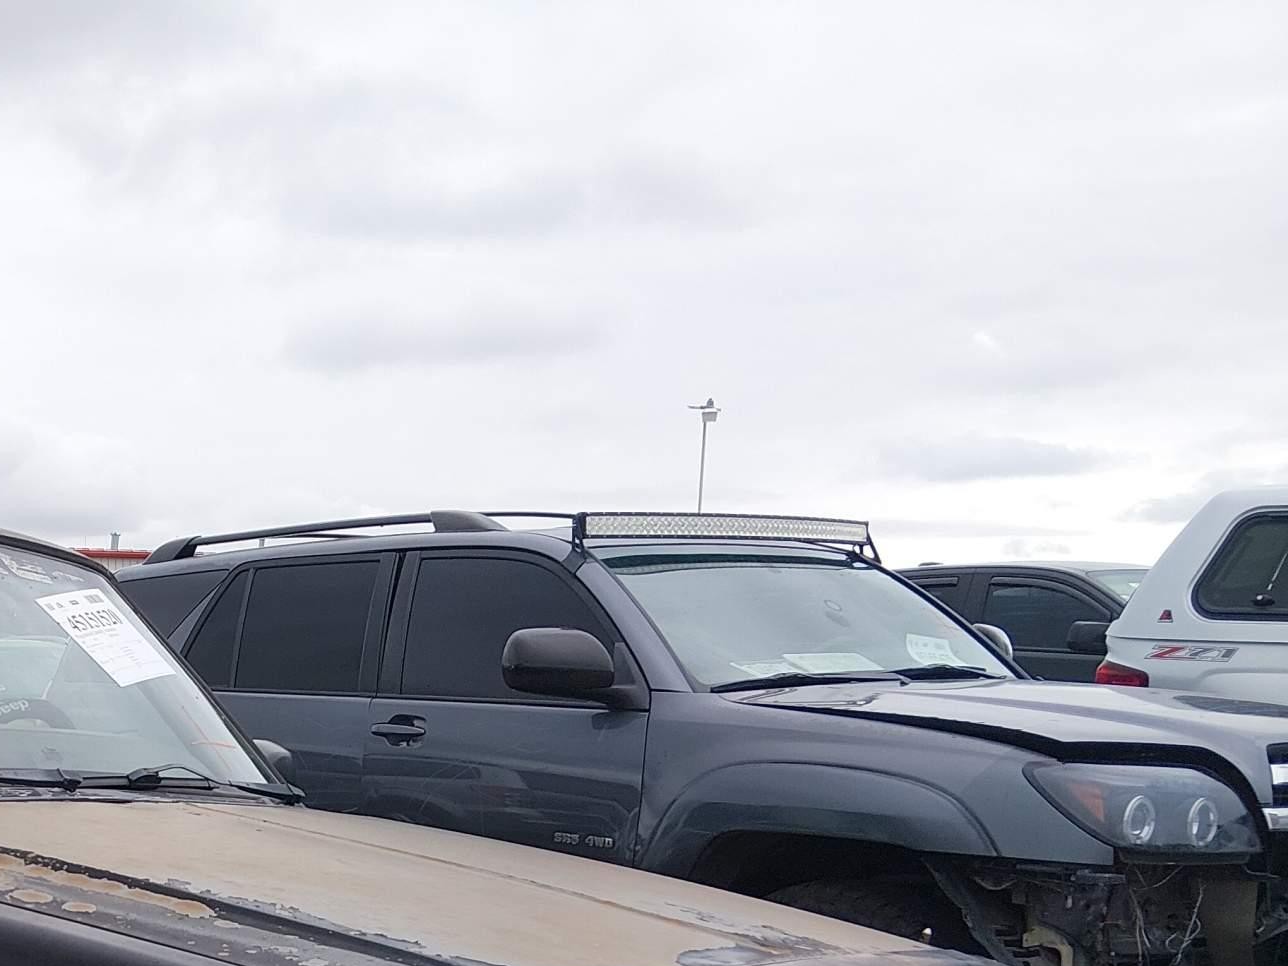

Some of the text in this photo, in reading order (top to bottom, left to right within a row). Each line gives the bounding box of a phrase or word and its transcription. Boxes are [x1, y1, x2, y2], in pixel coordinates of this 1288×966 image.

[67, 608, 124, 632] 45151520
[1144, 645, 1239, 663] Z71
[553, 832, 614, 848] SR5 4WD
